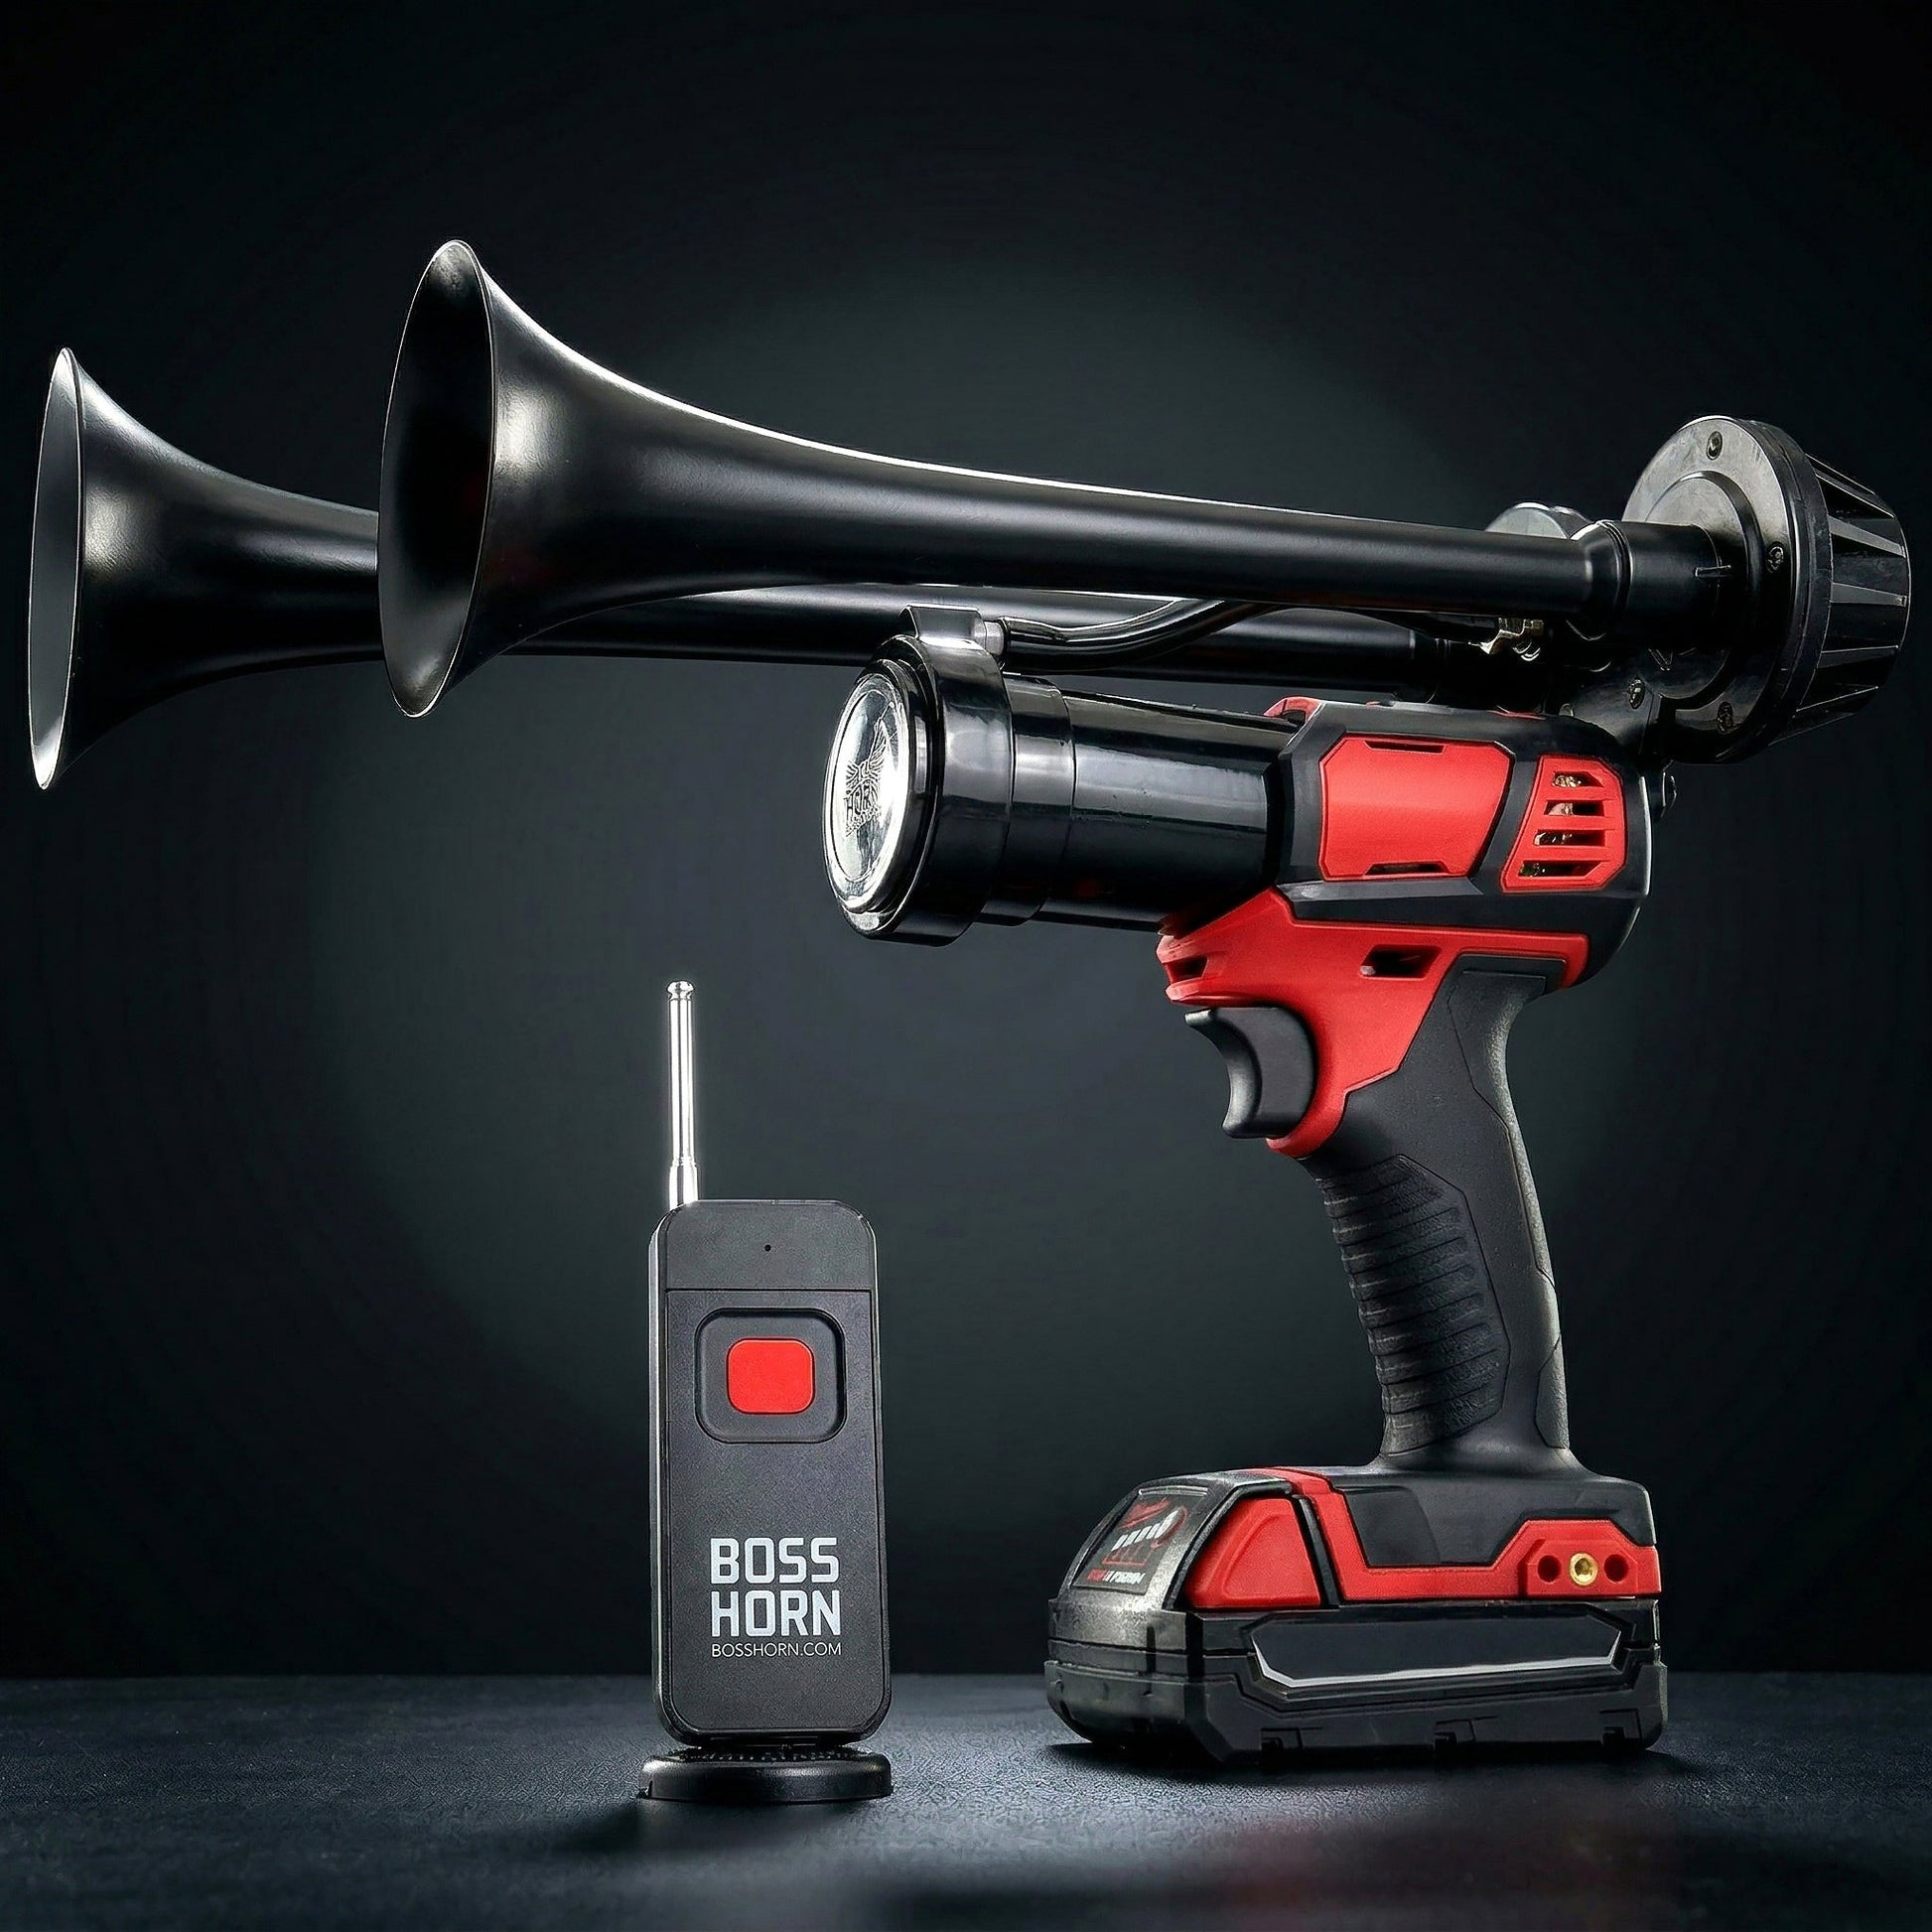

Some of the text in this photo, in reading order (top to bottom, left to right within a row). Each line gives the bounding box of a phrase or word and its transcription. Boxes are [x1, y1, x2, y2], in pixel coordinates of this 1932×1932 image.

[711, 1537, 840, 1585] BOSS
[711, 1589, 841, 1637] HORN
[711, 1641, 842, 1658] BOSSHORN.COM
